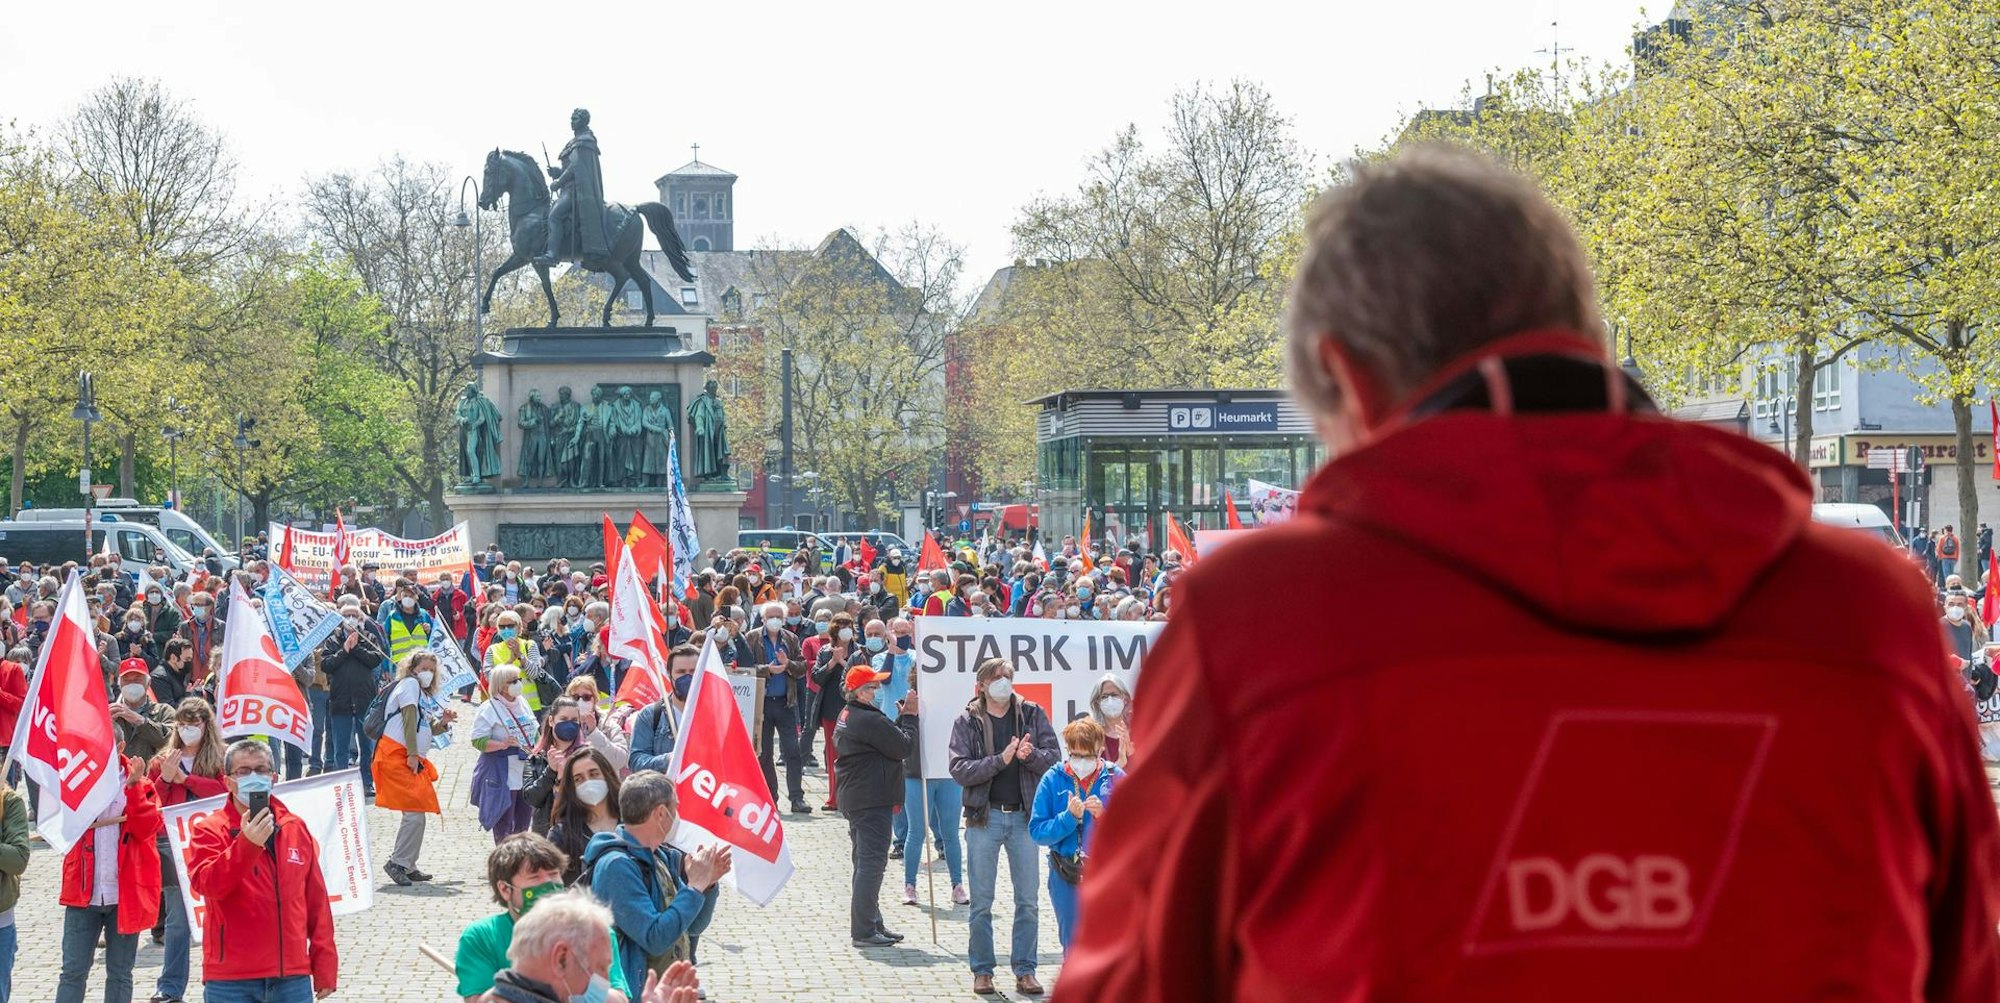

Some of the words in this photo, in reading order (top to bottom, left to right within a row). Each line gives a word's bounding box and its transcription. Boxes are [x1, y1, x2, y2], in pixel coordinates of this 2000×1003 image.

[1218, 411, 1273, 423] Heumarkt
[294, 556, 329, 568] heizen
[428, 557, 442, 567] an
[393, 547, 417, 559] TTIP
[421, 546, 437, 556] 2.0
[440, 545, 463, 554] usw.
[921, 634, 1072, 674] STARK
[1087, 635, 1149, 671] IM
[346, 783, 368, 880] Industriegewerkschaft
[347, 865, 358, 899] Energie
[1505, 852, 1694, 931] DGB
